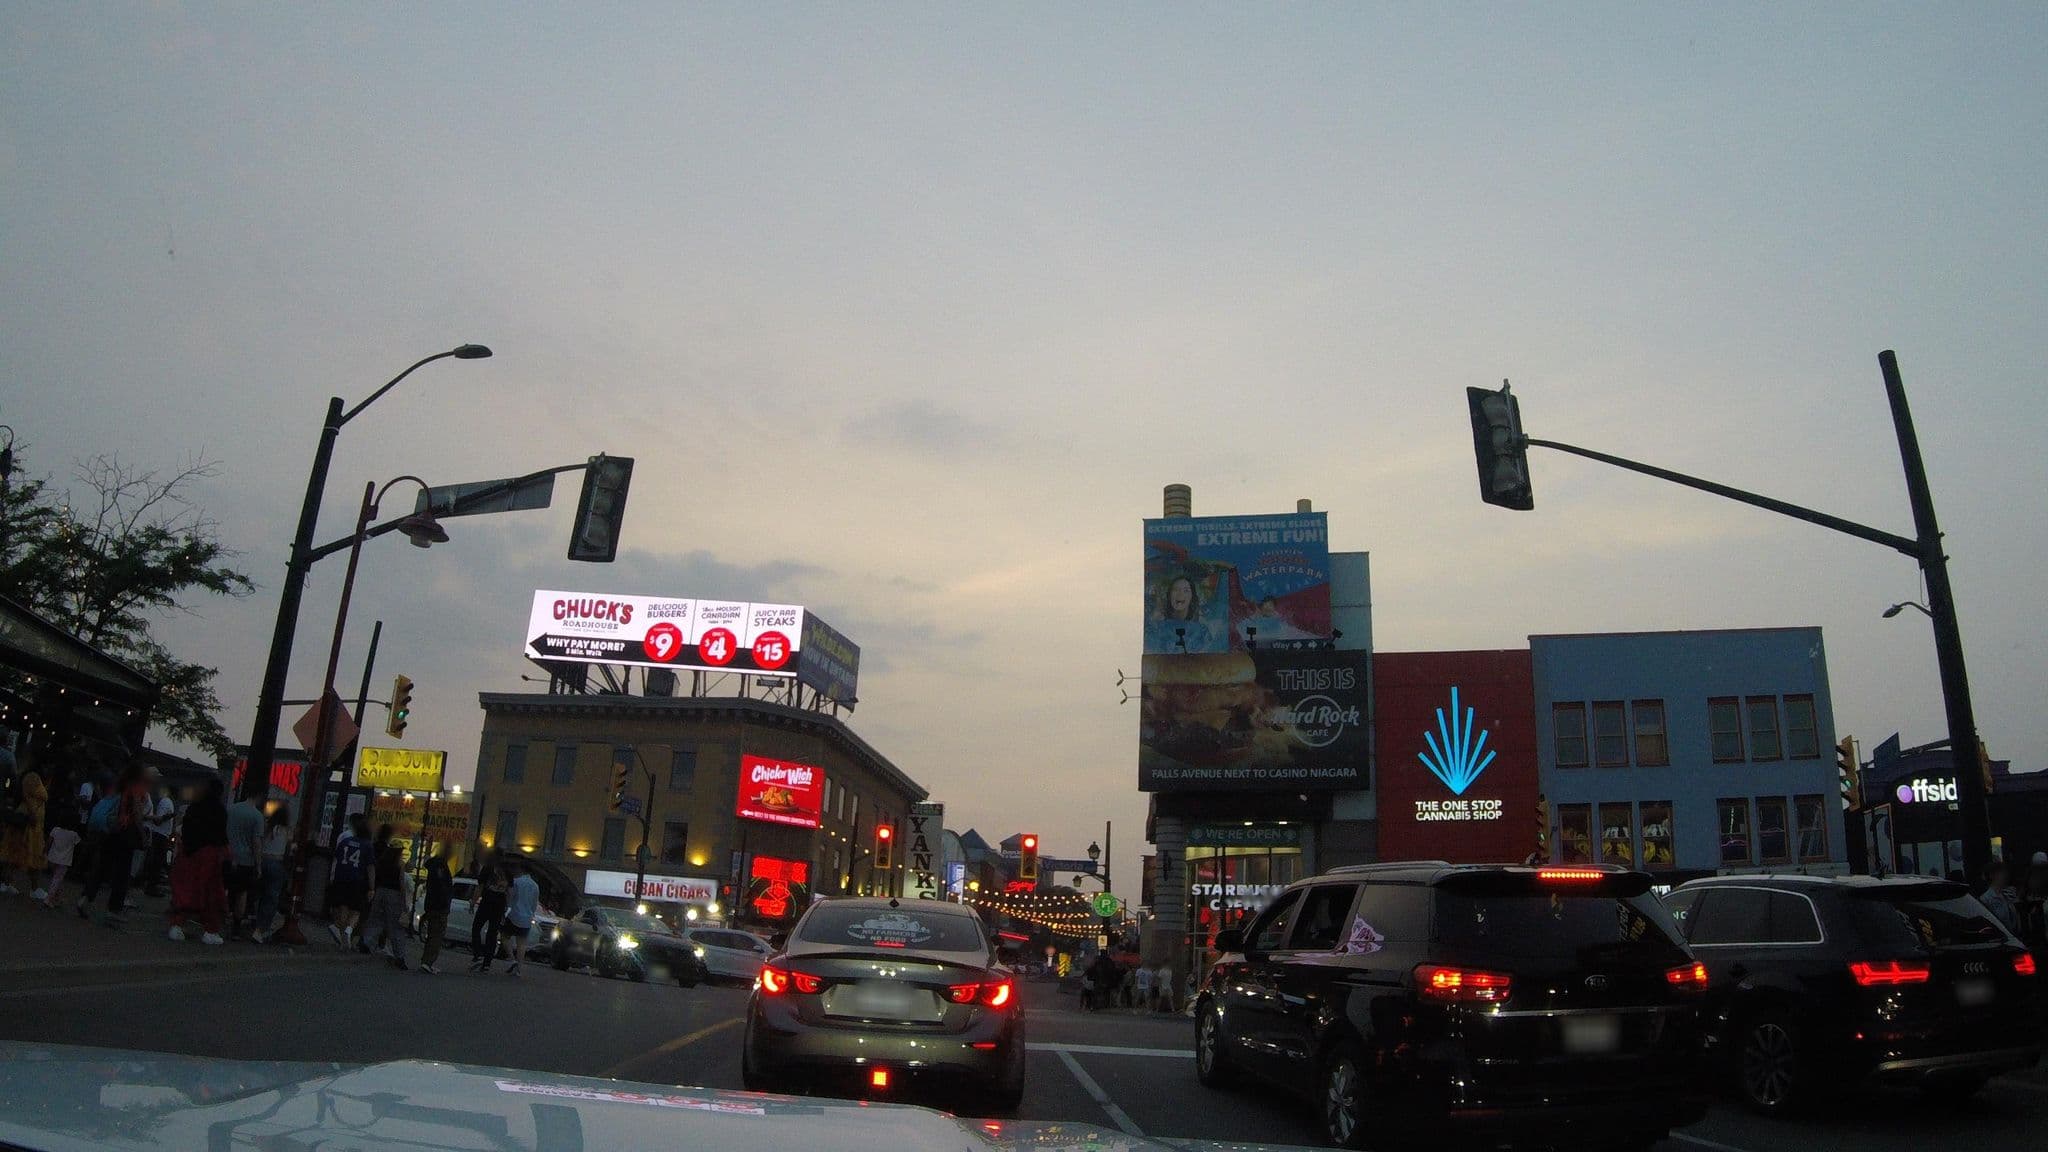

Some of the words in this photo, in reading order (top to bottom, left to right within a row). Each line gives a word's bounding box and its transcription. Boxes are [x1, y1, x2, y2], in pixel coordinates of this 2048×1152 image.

[1197, 530, 1279, 545] EXTREME
[1282, 527, 1325, 543] FUN!
[1242, 565, 1324, 581] WATERPARK
[553, 598, 634, 625] CHUCK'S
[647, 603, 688, 611] DELICIOUS
[754, 609, 778, 618] JUICY
[647, 610, 687, 619] BURGERS
[701, 611, 741, 619] CANADIAN
[562, 619, 619, 630] ROADHOUSE
[753, 617, 796, 627] STEAKS
[546, 637, 570, 648] WHY
[570, 639, 589, 650] PAY
[590, 641, 625, 652] MORE?
[703, 636, 727, 660] $4
[757, 643, 783, 661] $15
[1276, 668, 1331, 691] THIS
[1333, 667, 1356, 690] IS
[1271, 705, 1318, 725] Hard
[1319, 704, 1360, 727] Rock
[1152, 769, 1180, 780] FALLS
[1181, 769, 1223, 780] AVENUE
[1224, 769, 1251, 779] NEXT
[1253, 769, 1265, 779] TO
[1268, 768, 1308, 779] CASINO
[1310, 767, 1358, 778] NIAGARA
[1415, 800, 1440, 811] THE
[1443, 800, 1468, 811] ONE
[1470, 799, 1502, 810] STOP
[1415, 811, 1471, 821] CANNABIS
[1473, 810, 1502, 820] SHOP
[1206, 828, 1243, 841] WE'RE
[1247, 828, 1282, 840] OPEN
[341, 846, 361, 868] 14
[624, 880, 663, 897] CUBAN
[666, 884, 711, 899] CIGARS
